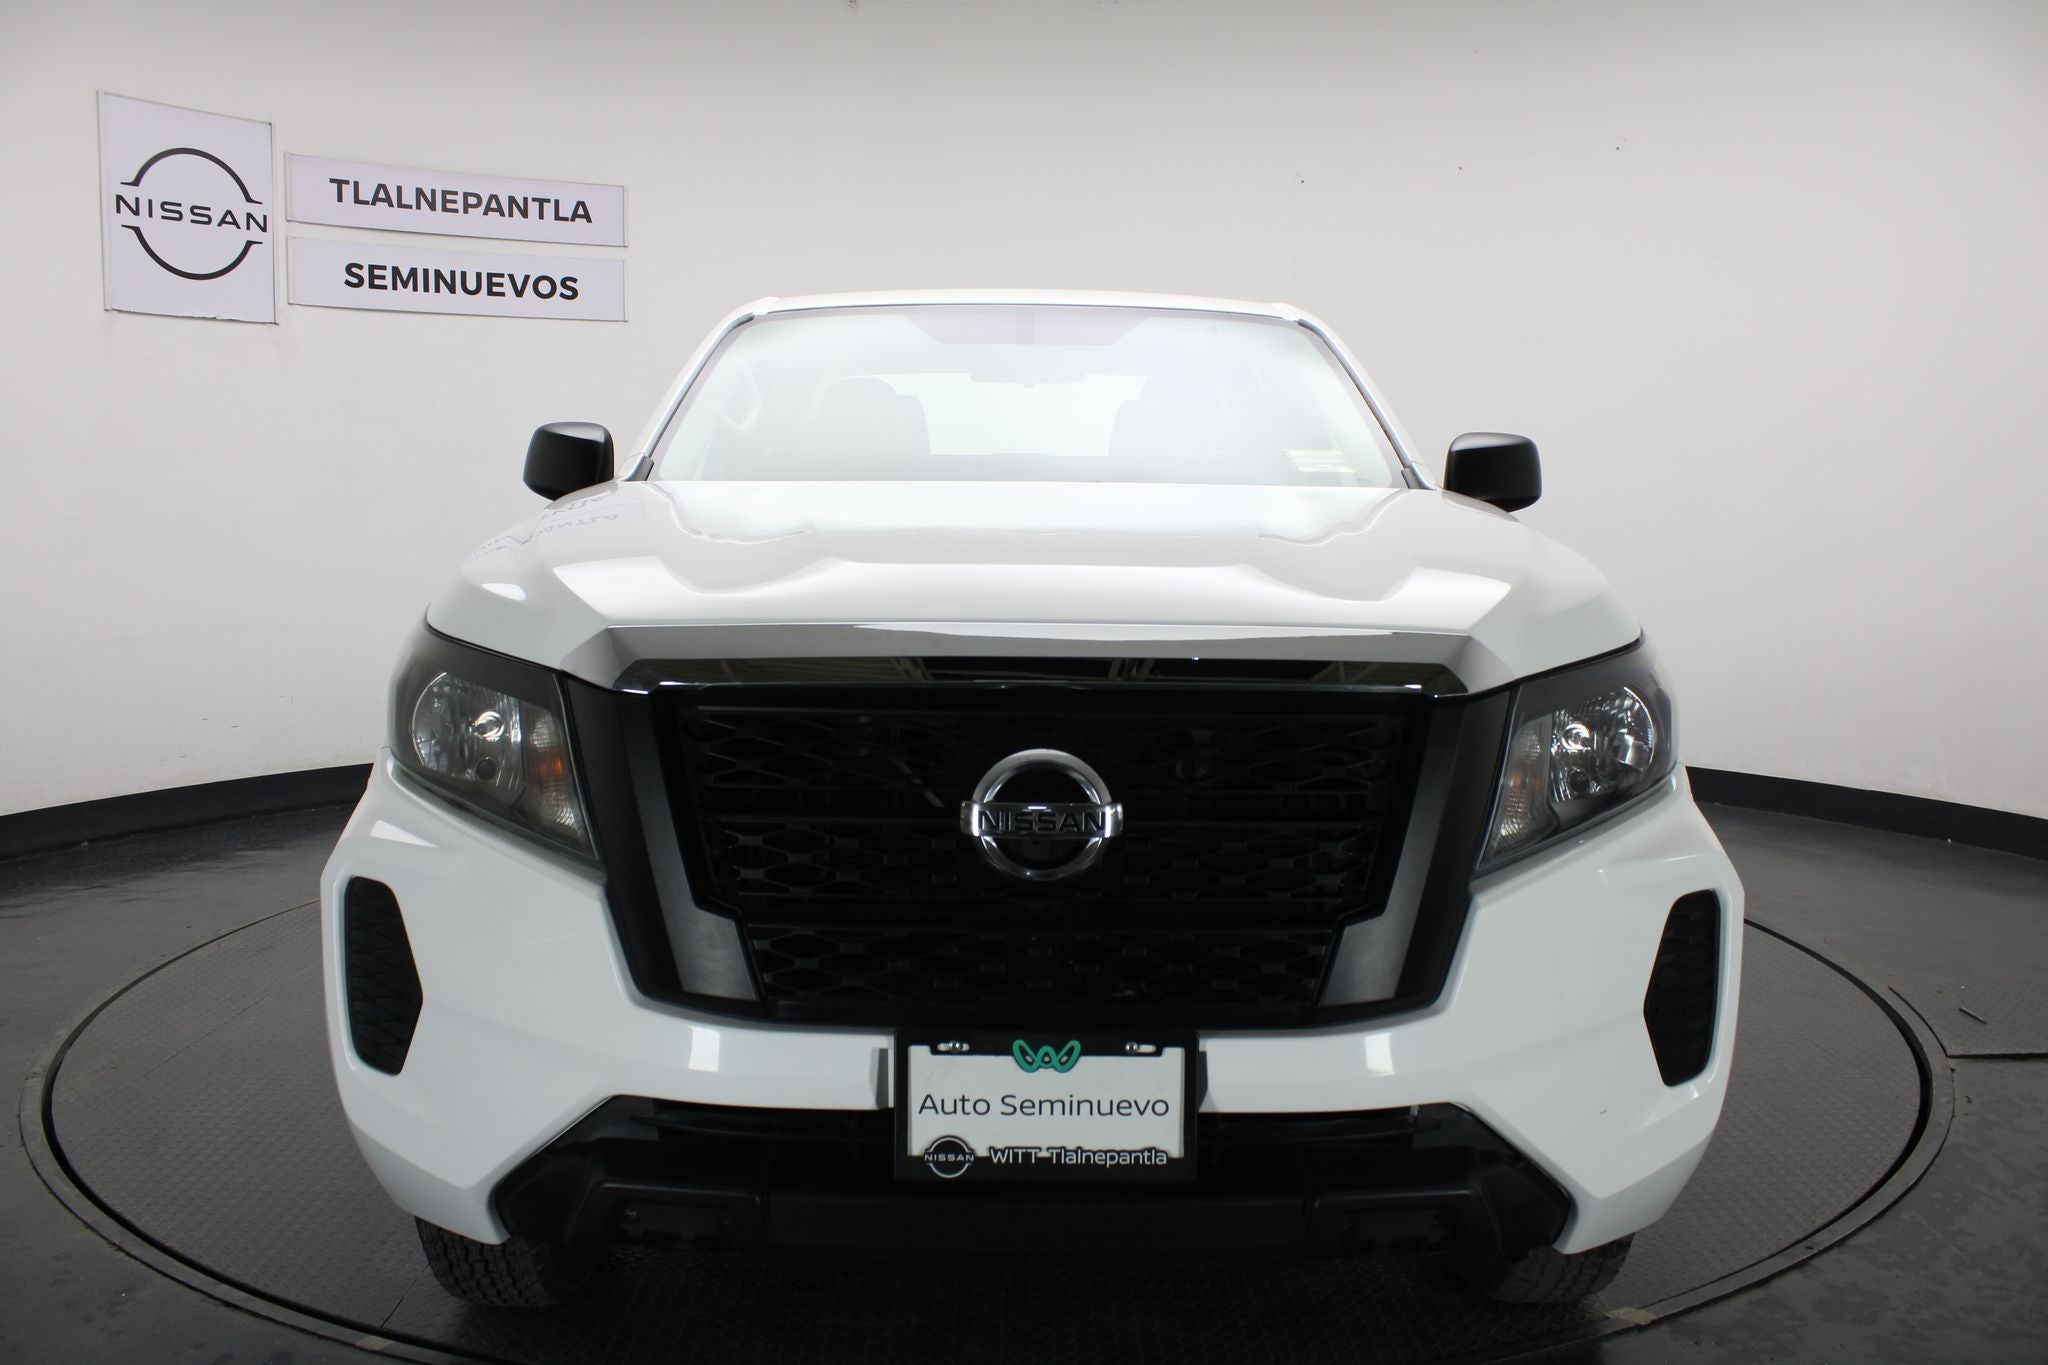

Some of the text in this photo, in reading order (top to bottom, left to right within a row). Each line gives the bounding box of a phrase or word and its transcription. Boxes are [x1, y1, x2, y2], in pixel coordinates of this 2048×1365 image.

[329, 178, 592, 223] TLALNEPANTLA
[115, 194, 268, 233] NISSAN
[343, 262, 580, 300] SEMINUEVOS
[980, 811, 1105, 832] NISSAN
[918, 1094, 1170, 1116] Auto Seminuevo
[924, 1154, 975, 1162] NISSAN
[990, 1149, 1168, 1168] WITT Tlalnepantla
